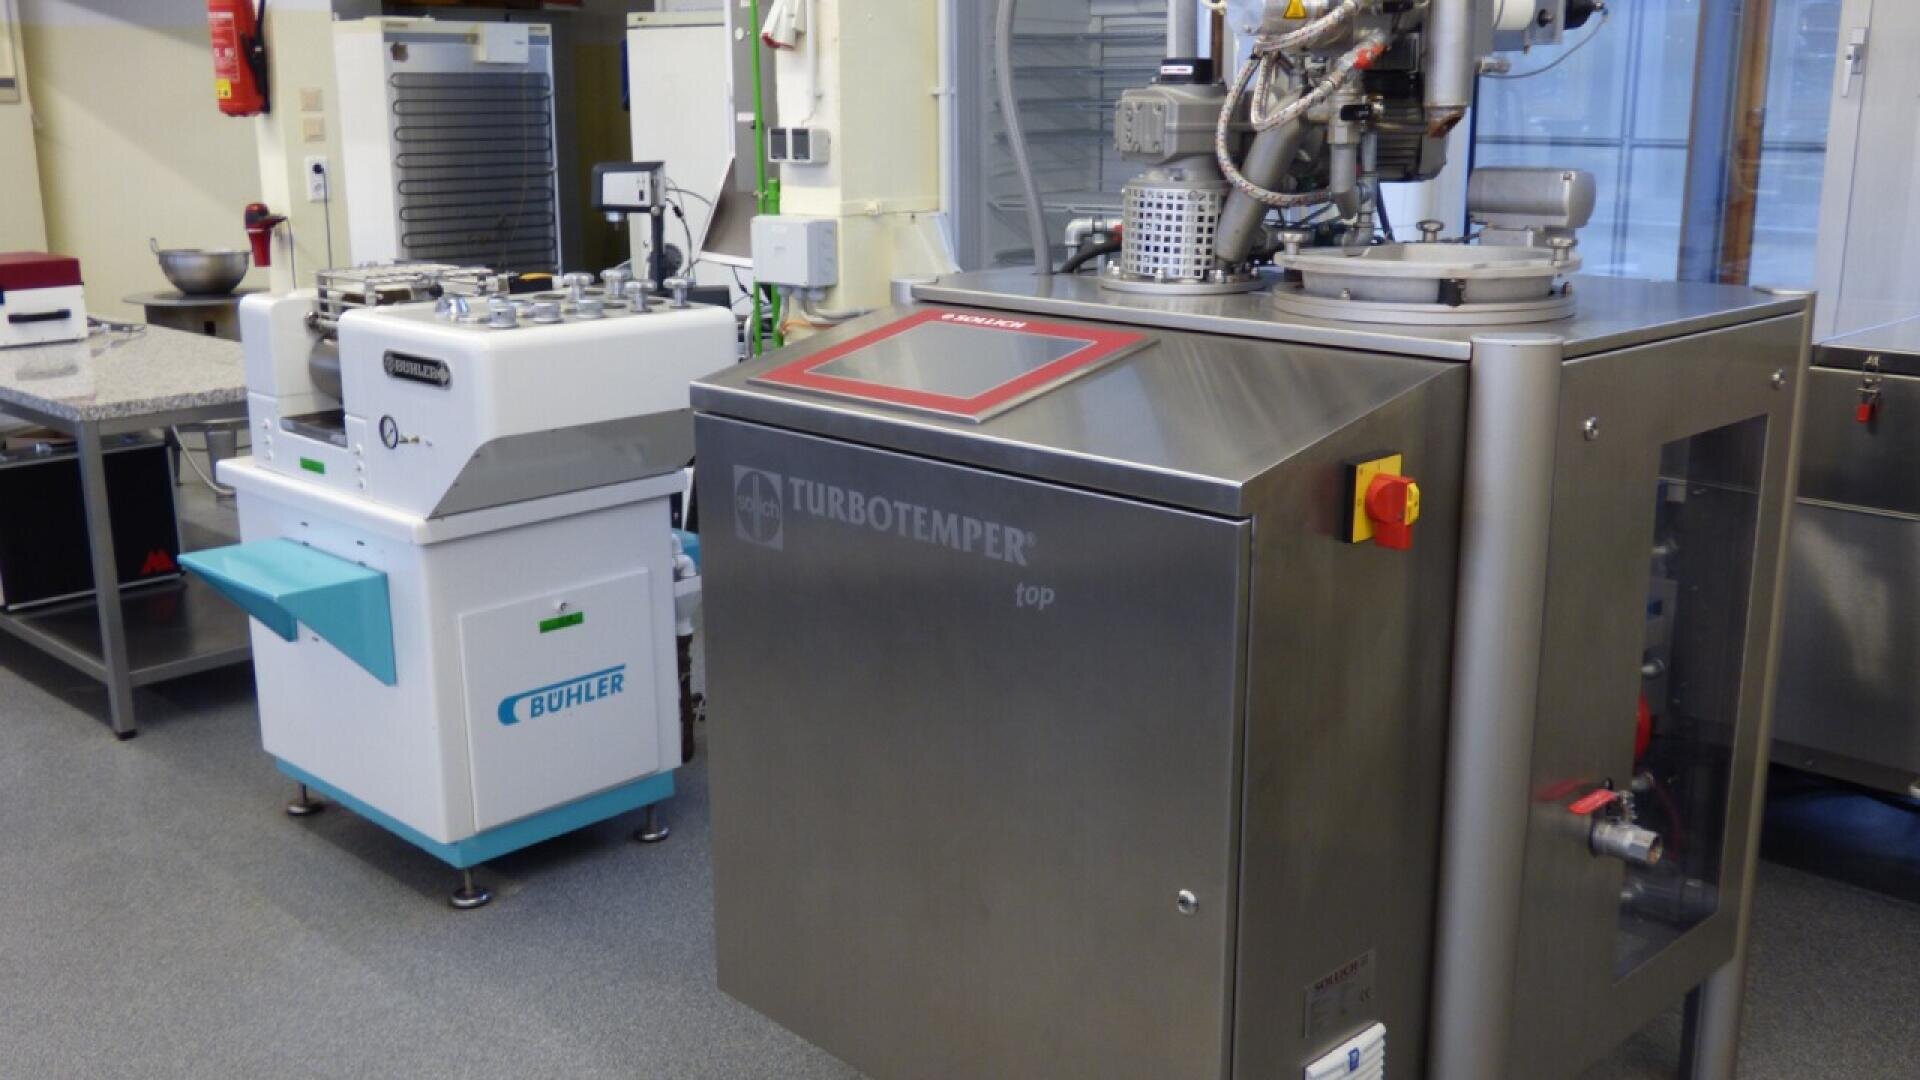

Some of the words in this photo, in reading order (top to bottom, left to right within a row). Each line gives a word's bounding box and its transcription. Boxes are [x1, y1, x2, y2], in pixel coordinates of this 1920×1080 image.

[953, 314, 1028, 329] SOLLICH
[1016, 581, 1056, 611] top
[529, 672, 625, 719] BÜHLER
